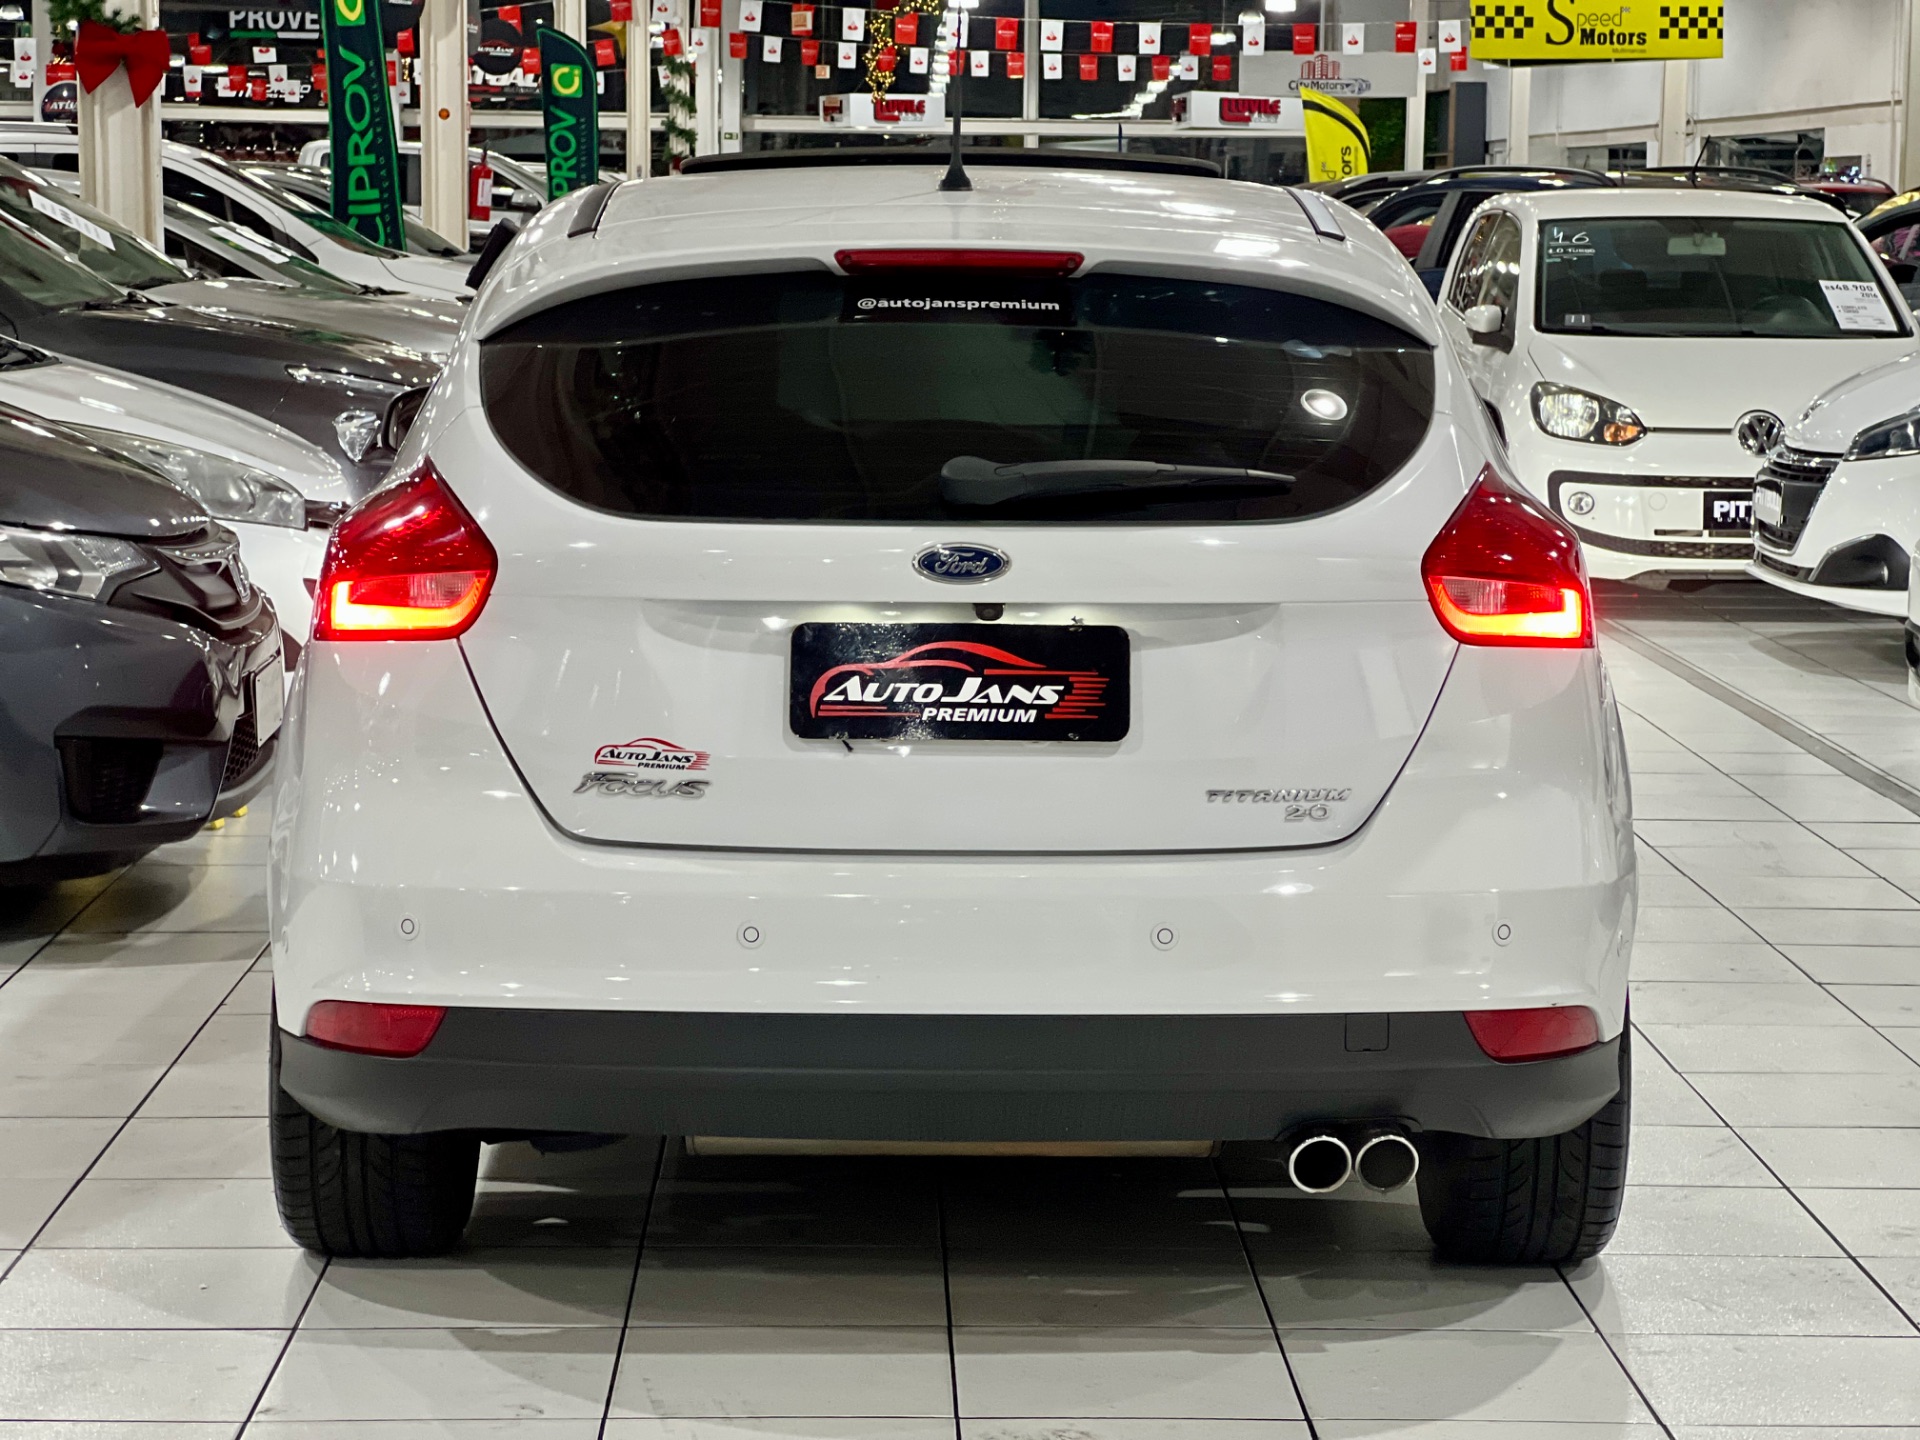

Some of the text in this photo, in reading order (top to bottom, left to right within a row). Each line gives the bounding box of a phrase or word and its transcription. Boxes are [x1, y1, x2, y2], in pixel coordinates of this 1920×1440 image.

[1579, 28, 1647, 46] Motors
[857, 298, 1060, 311] @autojanspremium
[935, 550, 988, 574] Ford
[921, 707, 1037, 723] PREMIUM
[637, 761, 686, 771] PREMIUM
[1205, 788, 1352, 803] TITANIUM
